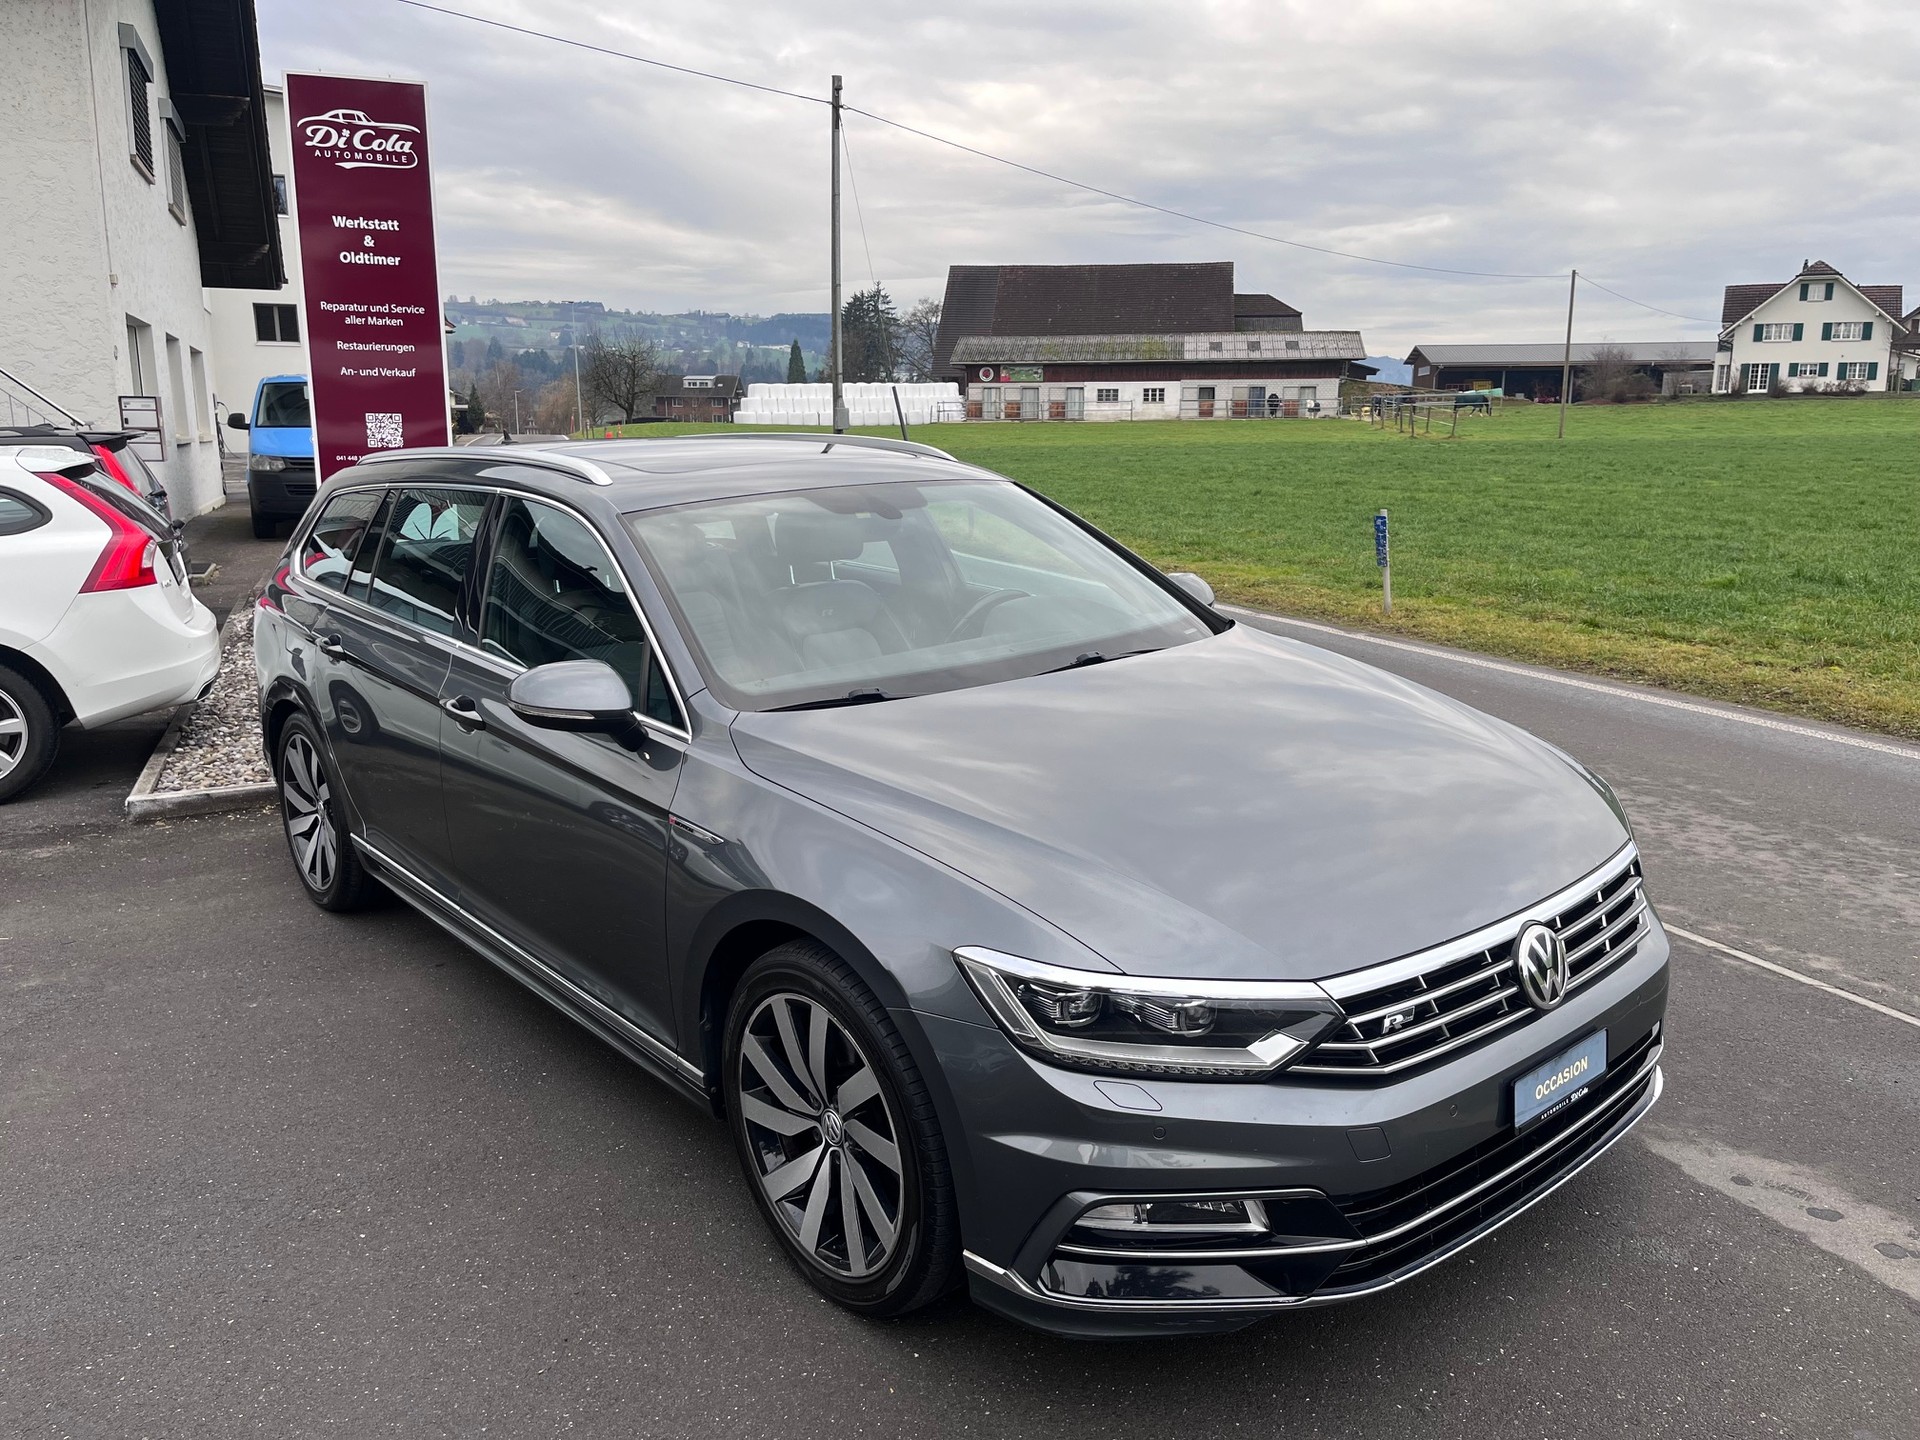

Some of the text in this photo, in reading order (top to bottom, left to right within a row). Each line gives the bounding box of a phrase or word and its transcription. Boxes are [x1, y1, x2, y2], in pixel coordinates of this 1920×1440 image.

[305, 125, 413, 153] Di Cola
[315, 150, 408, 163] AUTOMOBILE
[332, 215, 400, 231] Werkstatt
[363, 235, 375, 247] &
[340, 251, 401, 266] Oldtimer
[320, 301, 425, 314] Reparatur und Service
[345, 315, 404, 326] aller Marken
[336, 341, 415, 354] Restaurierungen
[340, 367, 416, 377] An- und Verkauf
[1535, 1056, 1588, 1100] OCCASION
[1541, 1098, 1569, 1119] AUTOMOBILE
